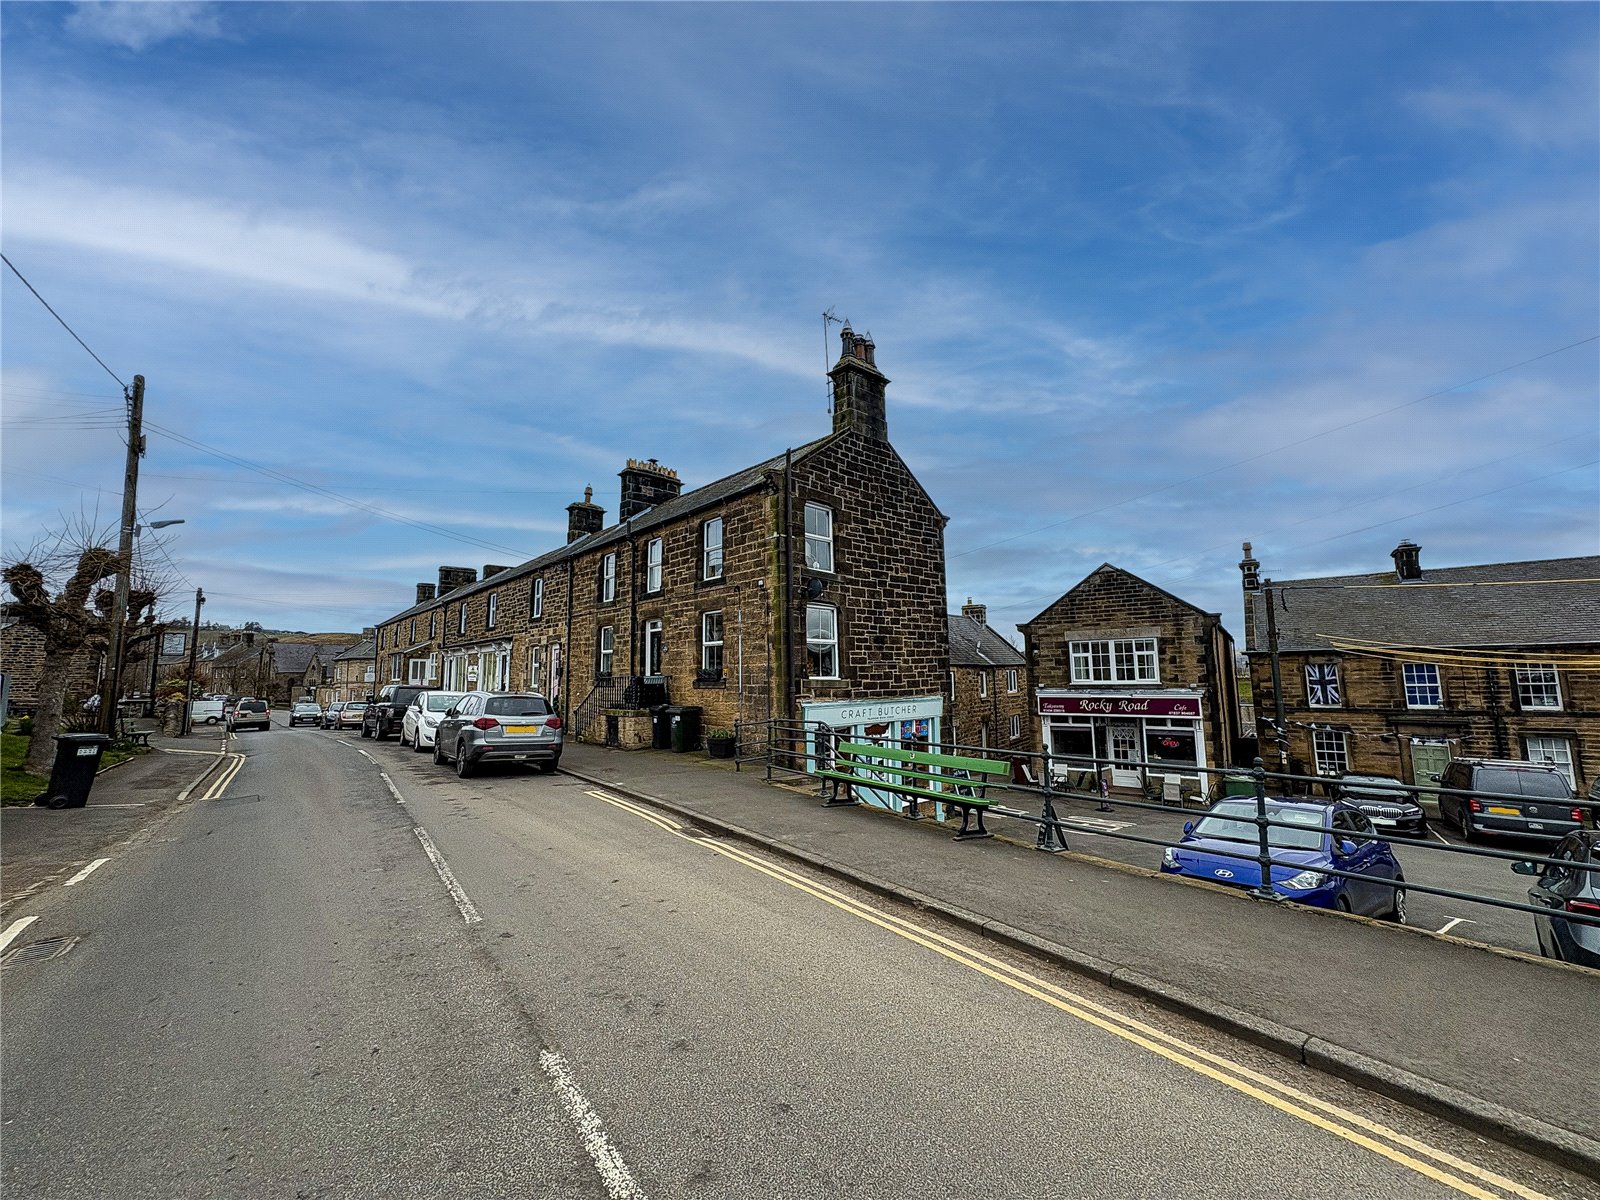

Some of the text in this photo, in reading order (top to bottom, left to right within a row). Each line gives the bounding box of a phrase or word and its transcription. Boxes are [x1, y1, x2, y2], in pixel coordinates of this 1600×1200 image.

[841, 705, 917, 719] CRAFT BUTCHER
[1080, 699, 1150, 713] Rocky Road
